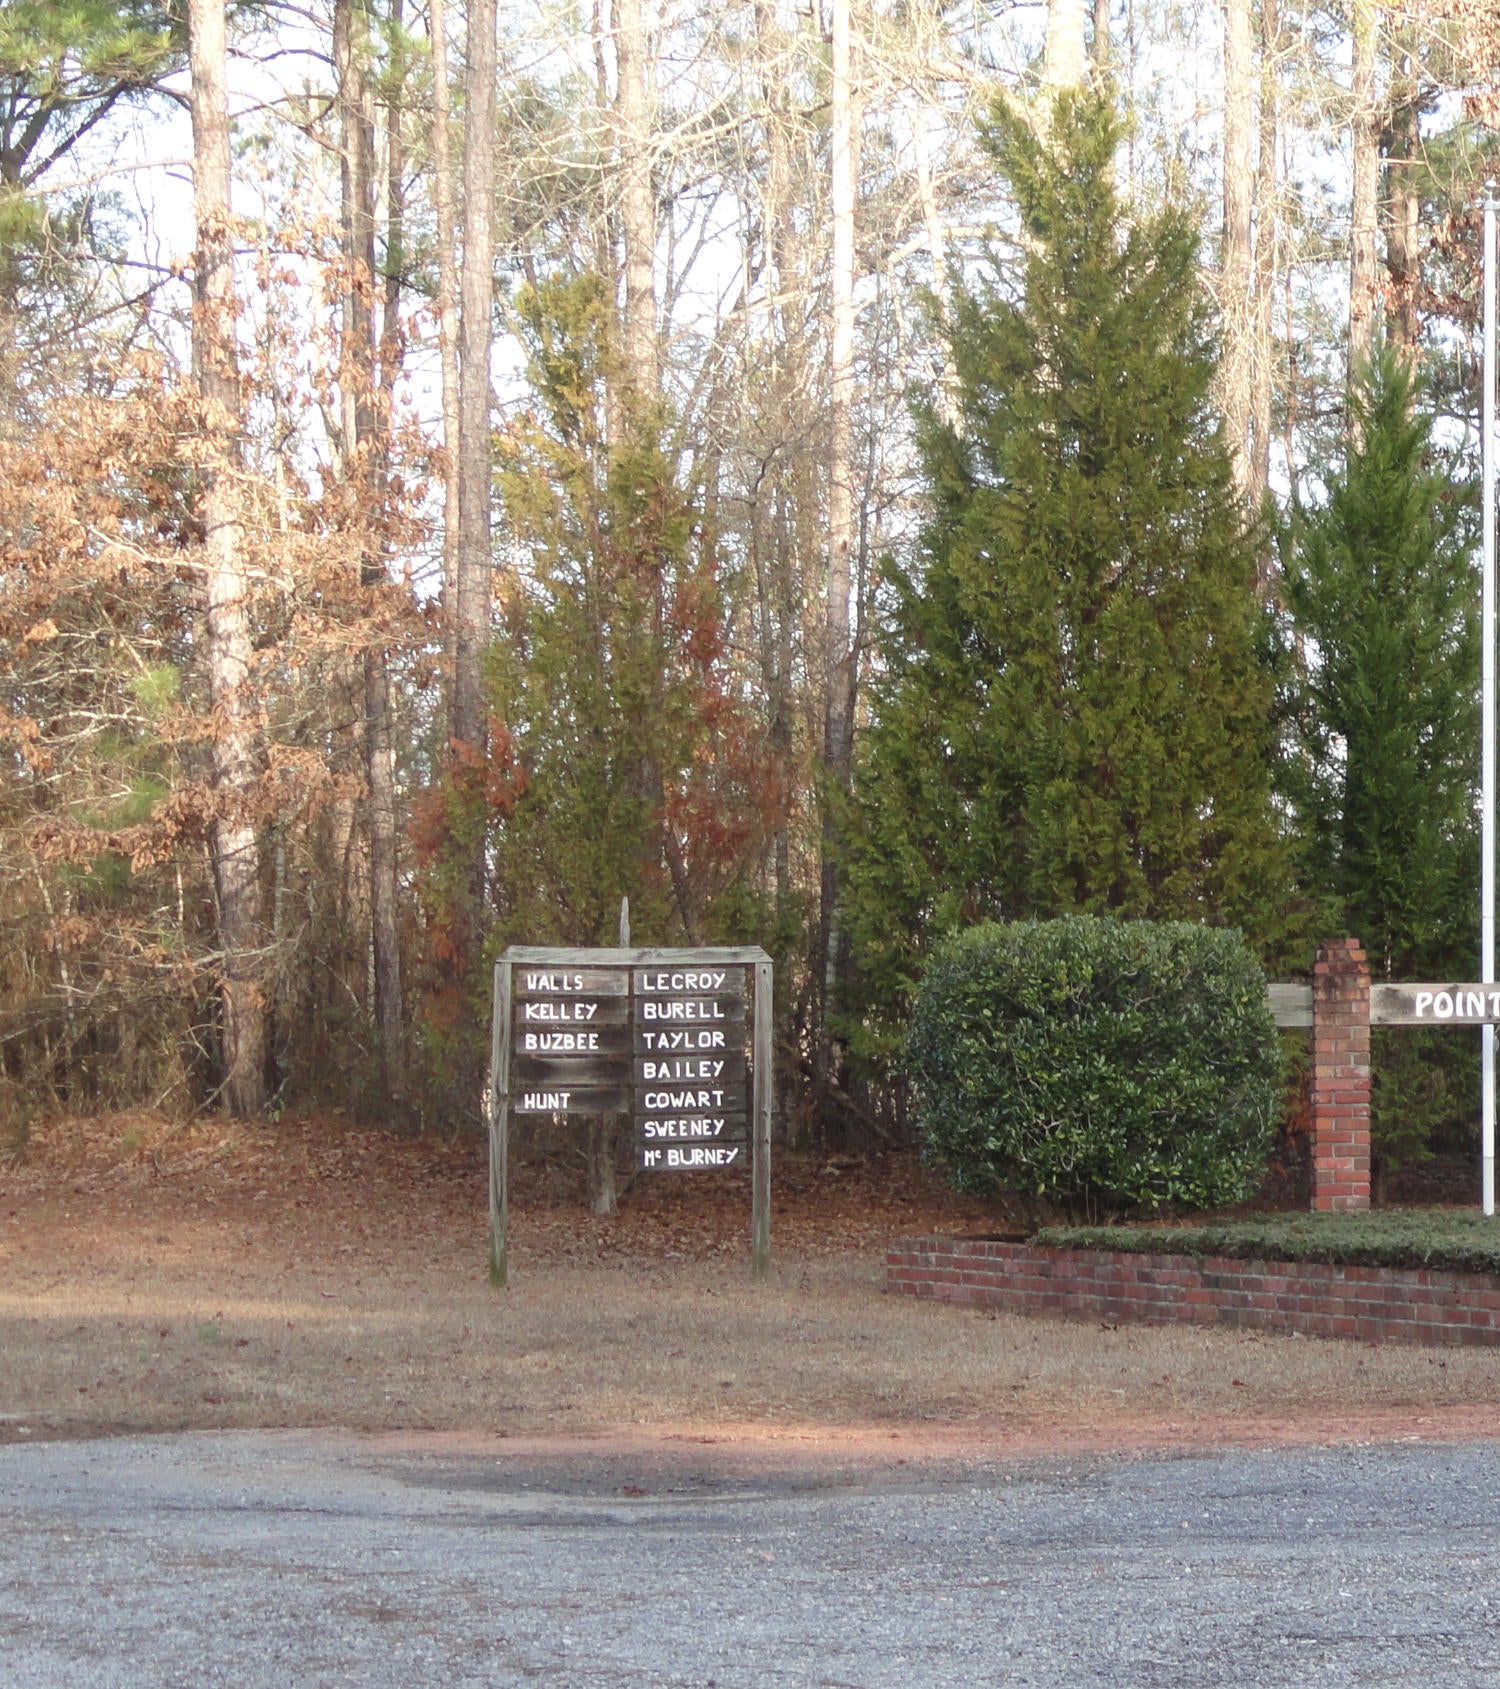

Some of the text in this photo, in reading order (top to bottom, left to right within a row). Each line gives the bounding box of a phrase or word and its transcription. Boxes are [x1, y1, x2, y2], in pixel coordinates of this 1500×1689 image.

[526, 974, 584, 991] WALLS
[643, 972, 726, 991] LECROY
[525, 1003, 598, 1020] KELLEY
[643, 1002, 725, 1020] BURELL
[525, 1033, 600, 1050] BUZBEE
[642, 1031, 726, 1050] TAYLOR
[643, 1060, 725, 1079] BAILEY
[524, 1092, 571, 1110] HUNT
[644, 1090, 724, 1109] COWART
[644, 1119, 725, 1138] SWEENEY
[668, 1147, 739, 1167] BURNEY
